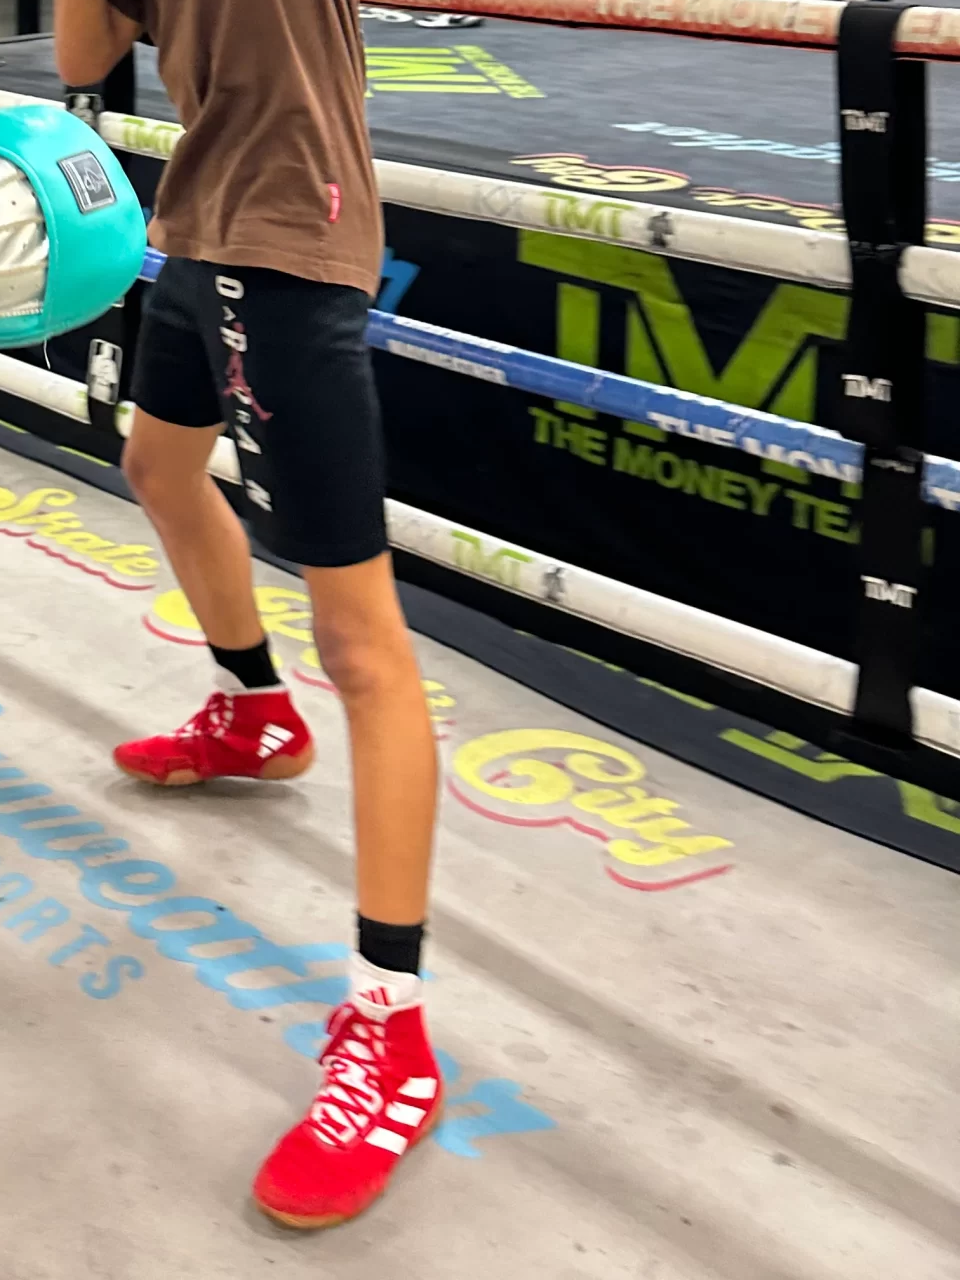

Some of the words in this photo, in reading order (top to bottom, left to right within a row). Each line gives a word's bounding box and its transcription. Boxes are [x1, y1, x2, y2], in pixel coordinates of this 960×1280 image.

[841, 109, 890, 133] TMT
[539, 190, 638, 239] TMT
[841, 373, 893, 402] TMT
[528, 407, 607, 466] THE
[612, 442, 782, 517] MONEY
[742, 436, 863, 485] MON
[450, 529, 534, 590] TMT
[860, 574, 919, 609] TMT
[452, 728, 735, 867] City
